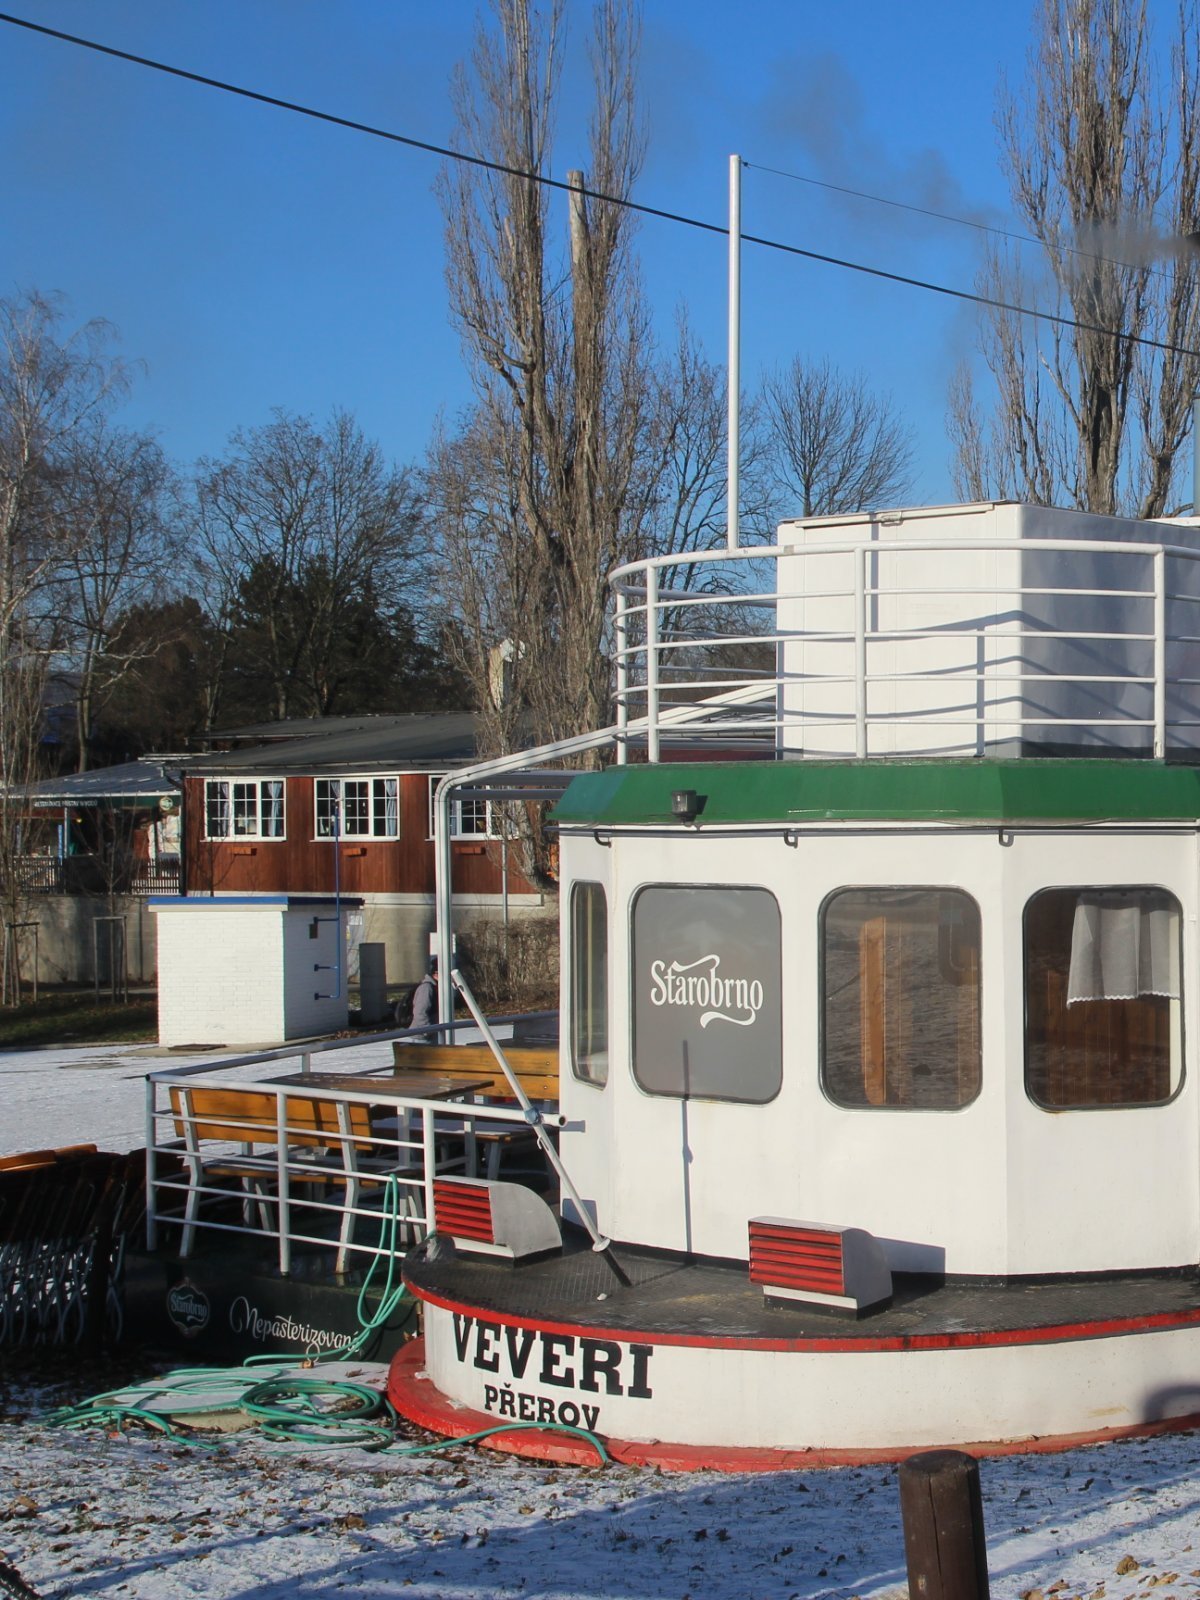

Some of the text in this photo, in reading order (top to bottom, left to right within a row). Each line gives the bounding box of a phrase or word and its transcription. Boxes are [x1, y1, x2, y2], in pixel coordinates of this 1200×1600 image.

[650, 953, 764, 1029] Starobrno
[452, 1312, 654, 1399] VEVERI
[484, 1382, 601, 1431] PŘEROV
